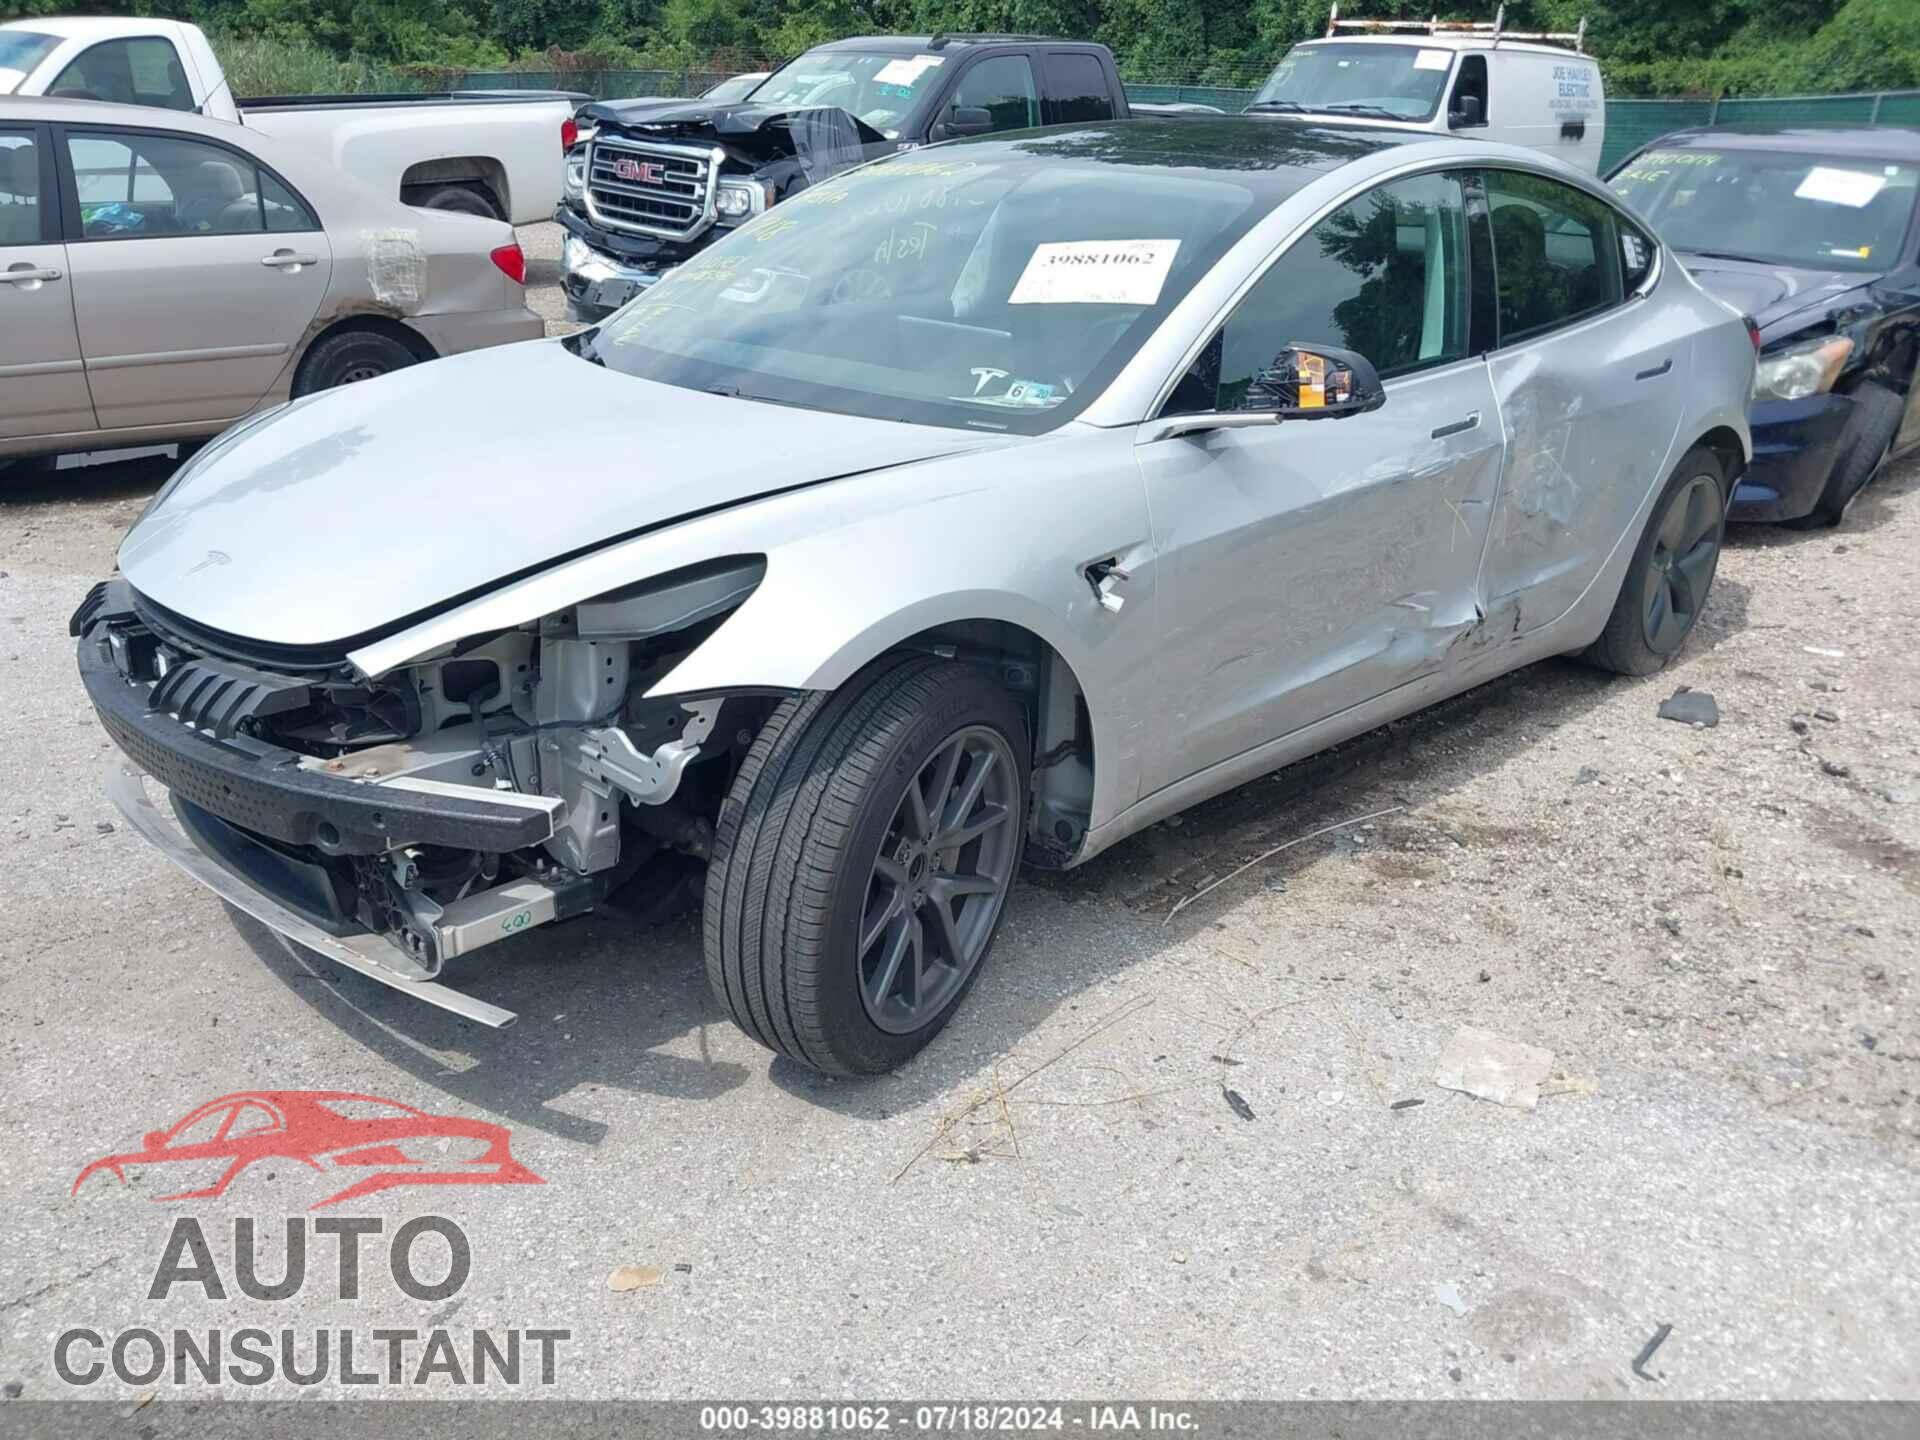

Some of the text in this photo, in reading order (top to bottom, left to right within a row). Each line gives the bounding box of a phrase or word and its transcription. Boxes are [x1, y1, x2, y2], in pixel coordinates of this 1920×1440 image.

[1552, 66, 1566, 81] JOE
[615, 158, 664, 184] GMC
[1048, 252, 1156, 265] 39881062
[1011, 385, 1024, 398] 6
